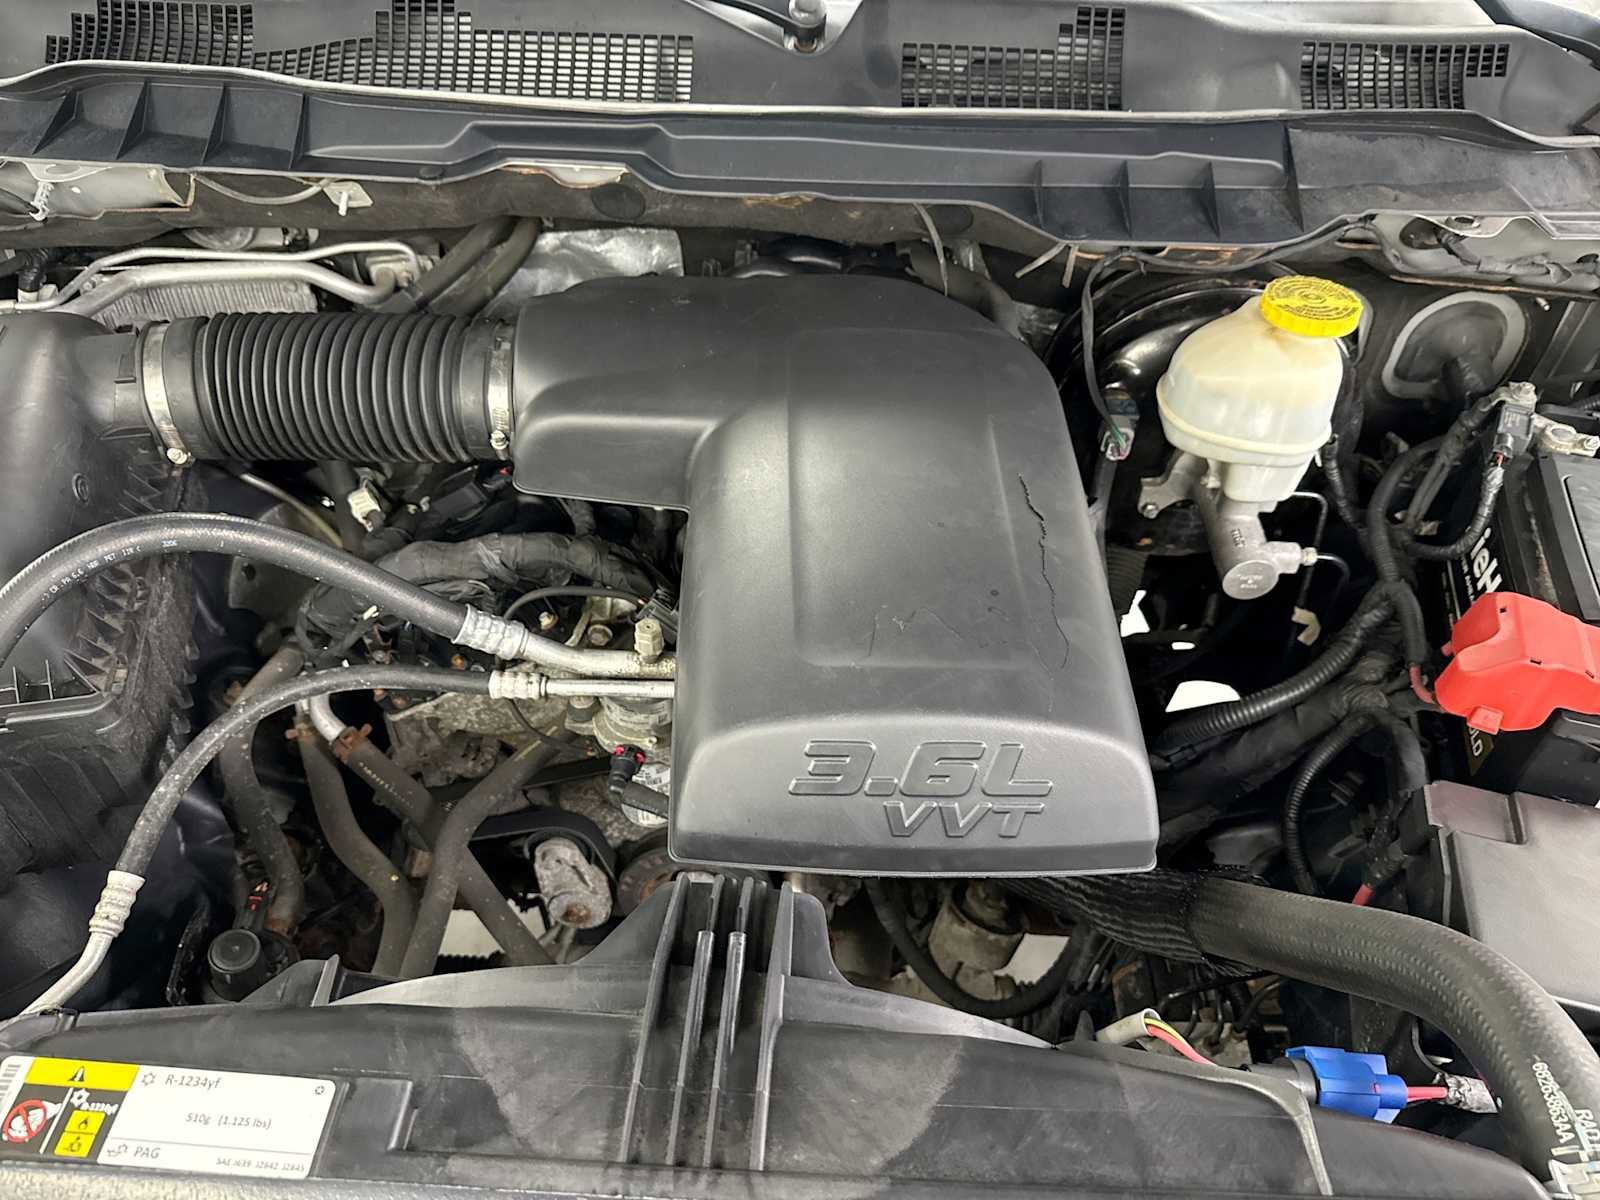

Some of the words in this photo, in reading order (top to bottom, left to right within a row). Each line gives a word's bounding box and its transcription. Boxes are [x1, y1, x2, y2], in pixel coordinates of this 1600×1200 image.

[788, 740, 1053, 797] 3.6L
[883, 801, 1045, 838] VVT
[165, 1073, 221, 1091] R-1234yf
[133, 1145, 161, 1159] PAG
